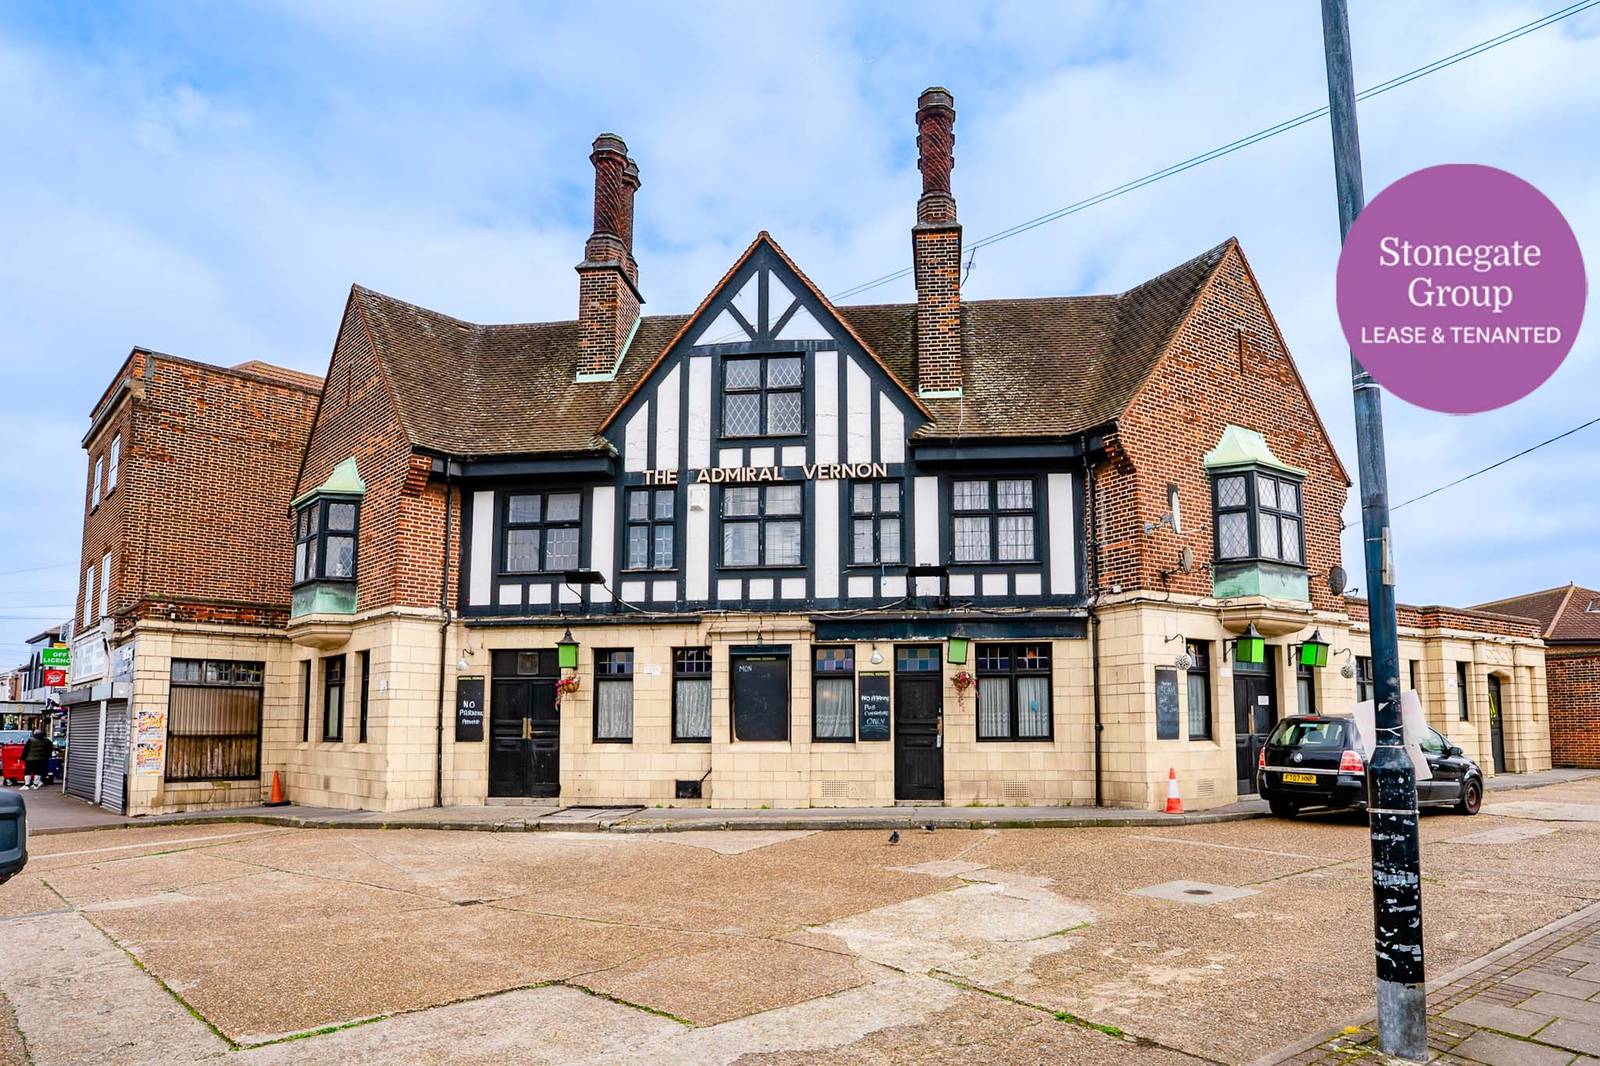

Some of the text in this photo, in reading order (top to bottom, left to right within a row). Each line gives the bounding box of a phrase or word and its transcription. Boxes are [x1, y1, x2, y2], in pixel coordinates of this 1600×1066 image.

[643, 463, 888, 485] THE ADMIRAL VERNON
[463, 700, 476, 709] NO
